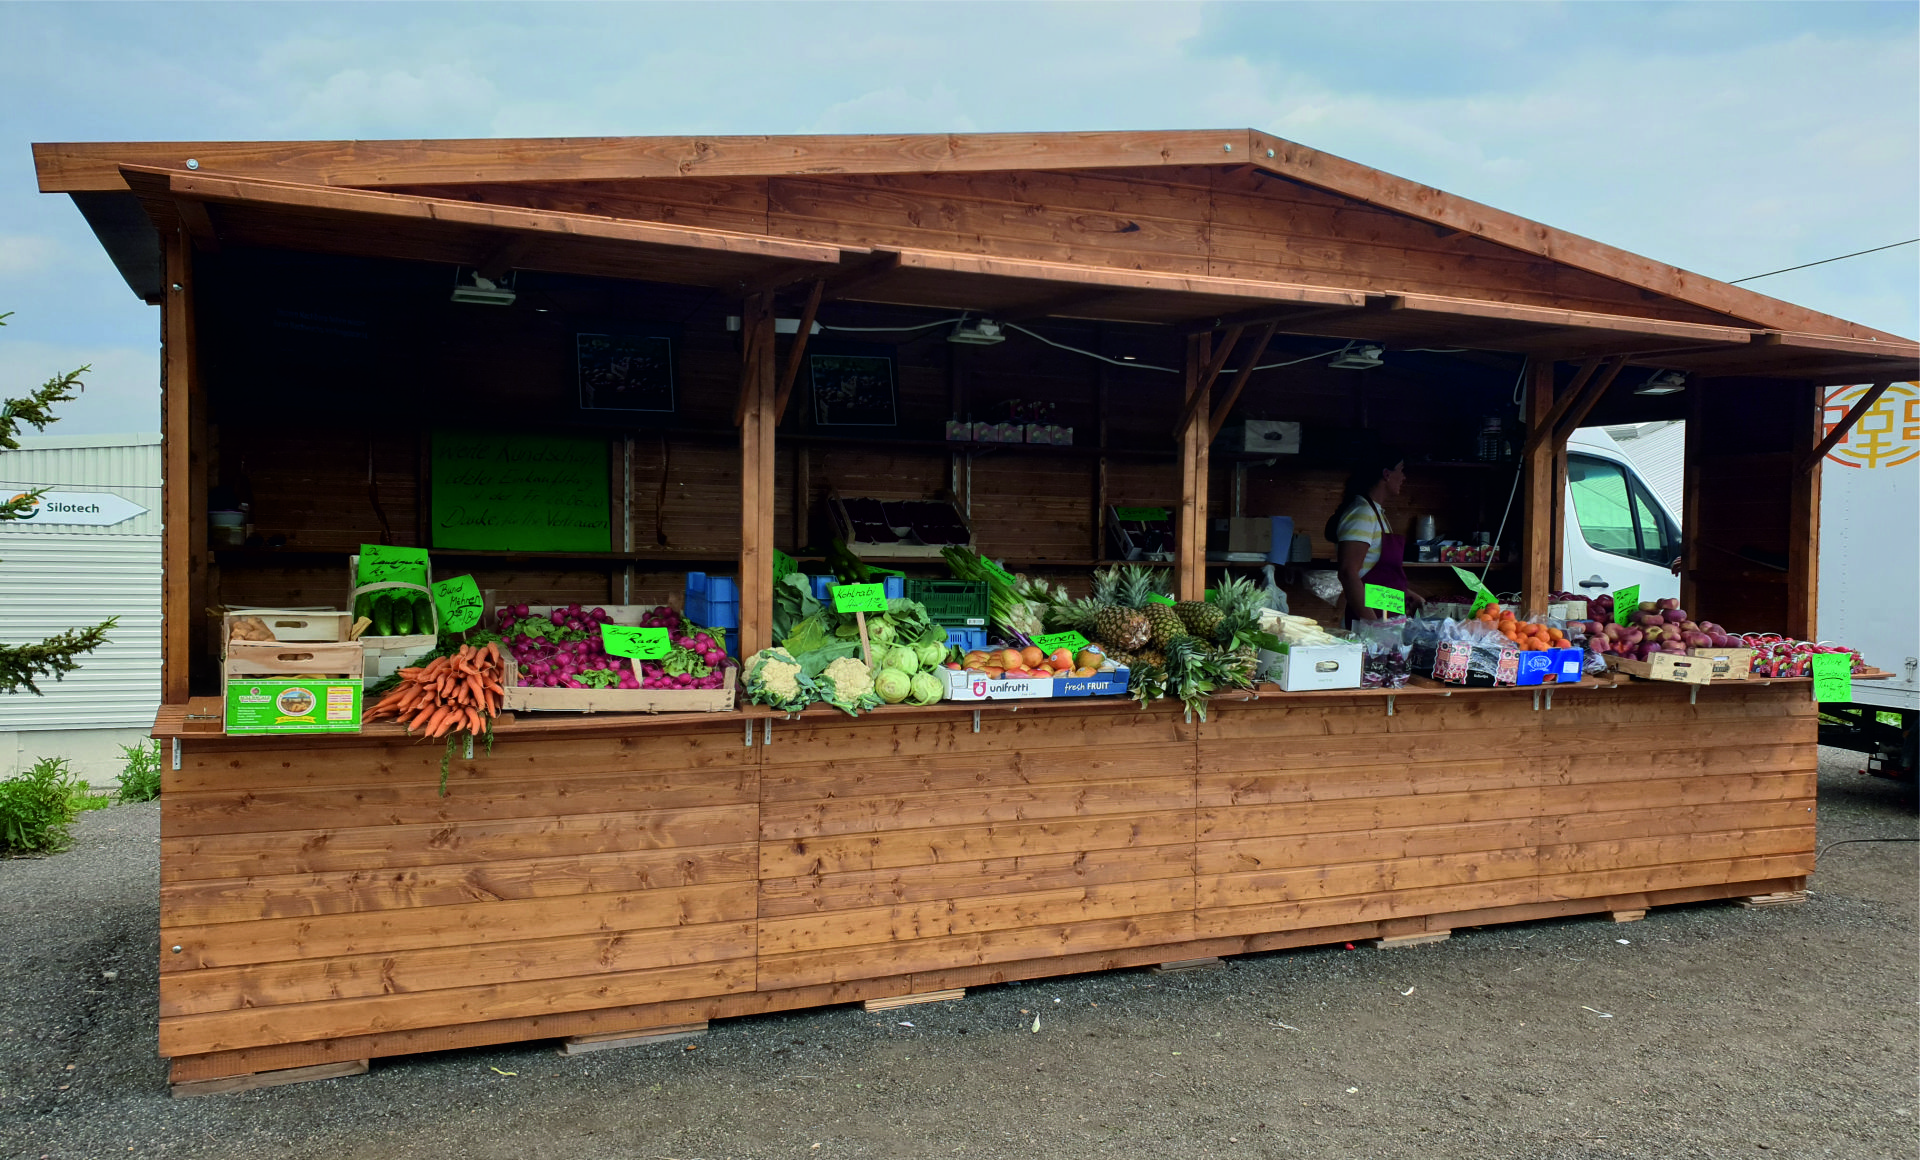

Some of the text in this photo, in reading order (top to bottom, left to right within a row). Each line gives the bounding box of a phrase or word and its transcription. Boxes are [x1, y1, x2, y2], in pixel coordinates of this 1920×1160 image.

[46, 502, 100, 513] Silotech
[439, 582, 464, 597] Bund
[1037, 634, 1076, 645] Birnen
[989, 682, 1029, 693] unifrutti
[1064, 682, 1109, 693] fresh FRUIT
